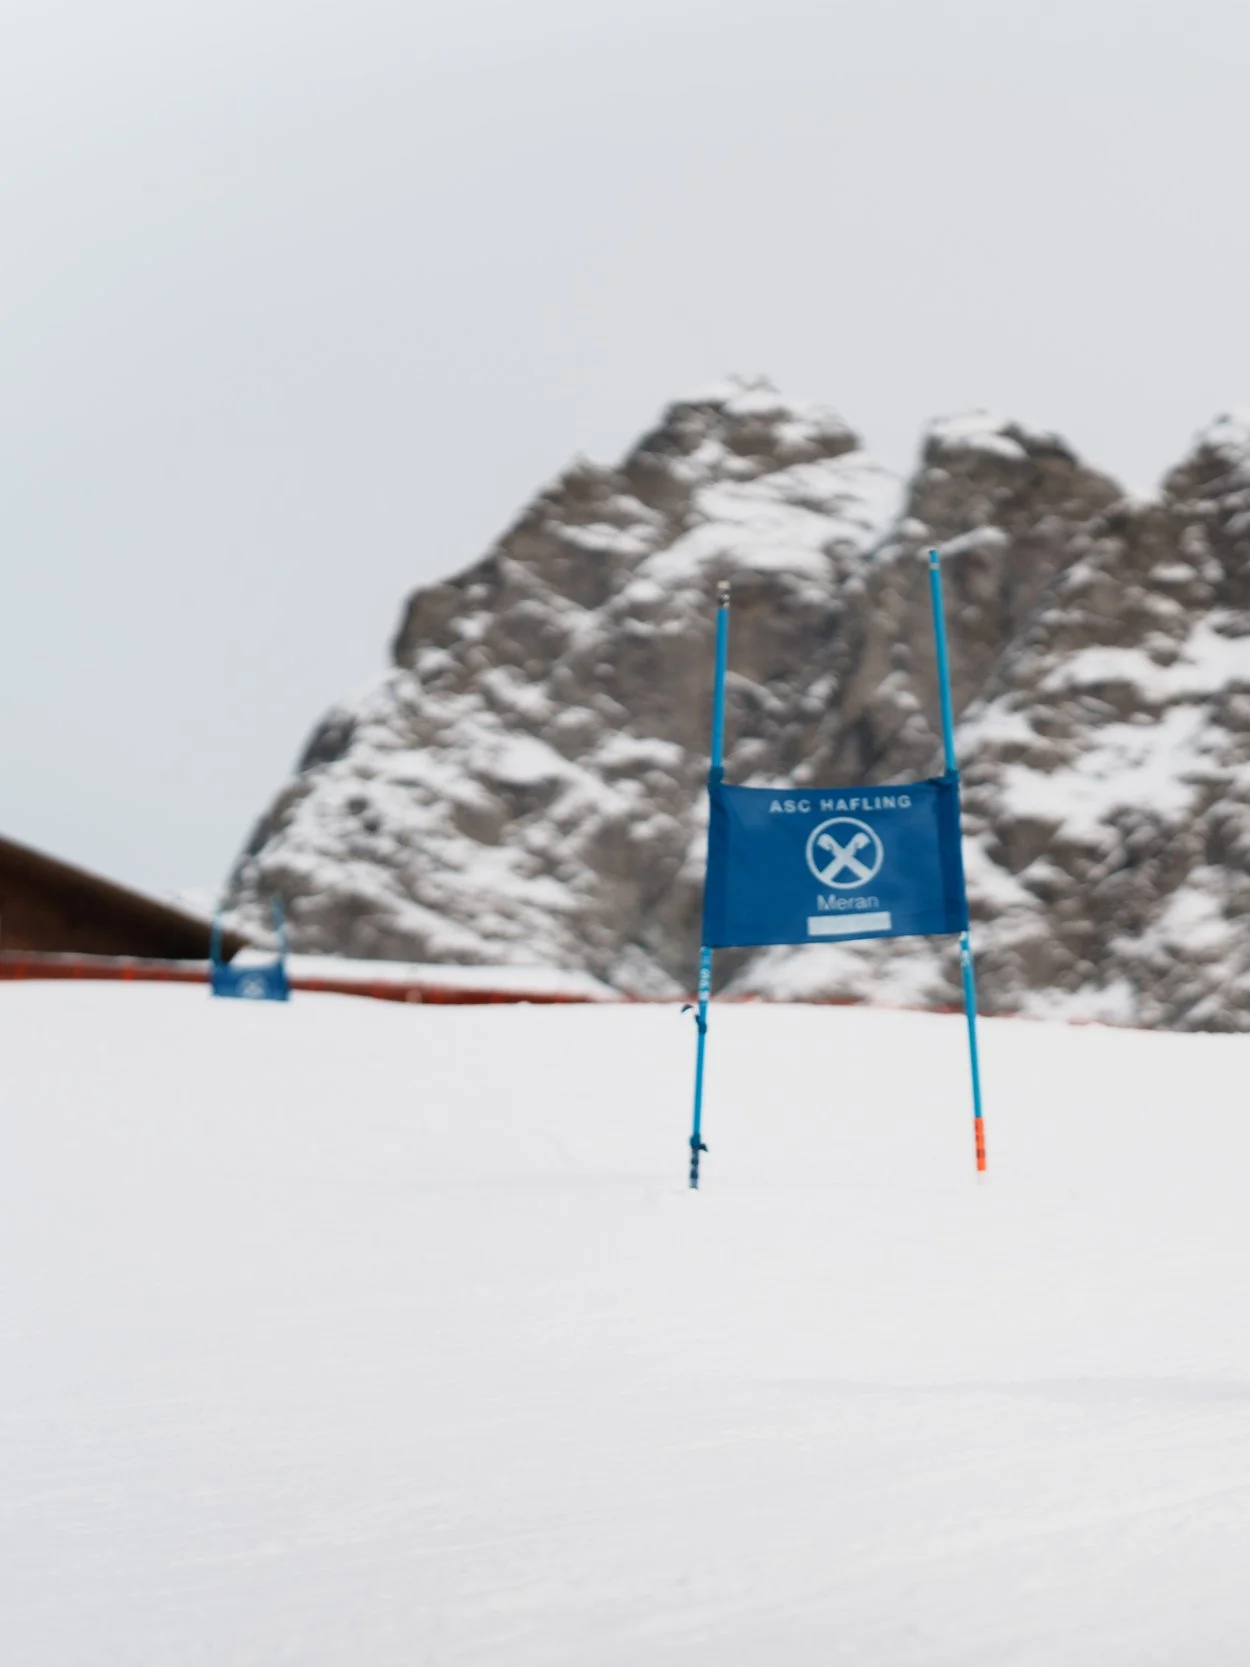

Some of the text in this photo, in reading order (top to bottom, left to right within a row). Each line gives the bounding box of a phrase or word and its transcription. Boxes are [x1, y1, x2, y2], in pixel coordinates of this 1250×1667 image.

[769, 795, 912, 813] ASC HAFLING
[816, 893, 880, 911] Meran
